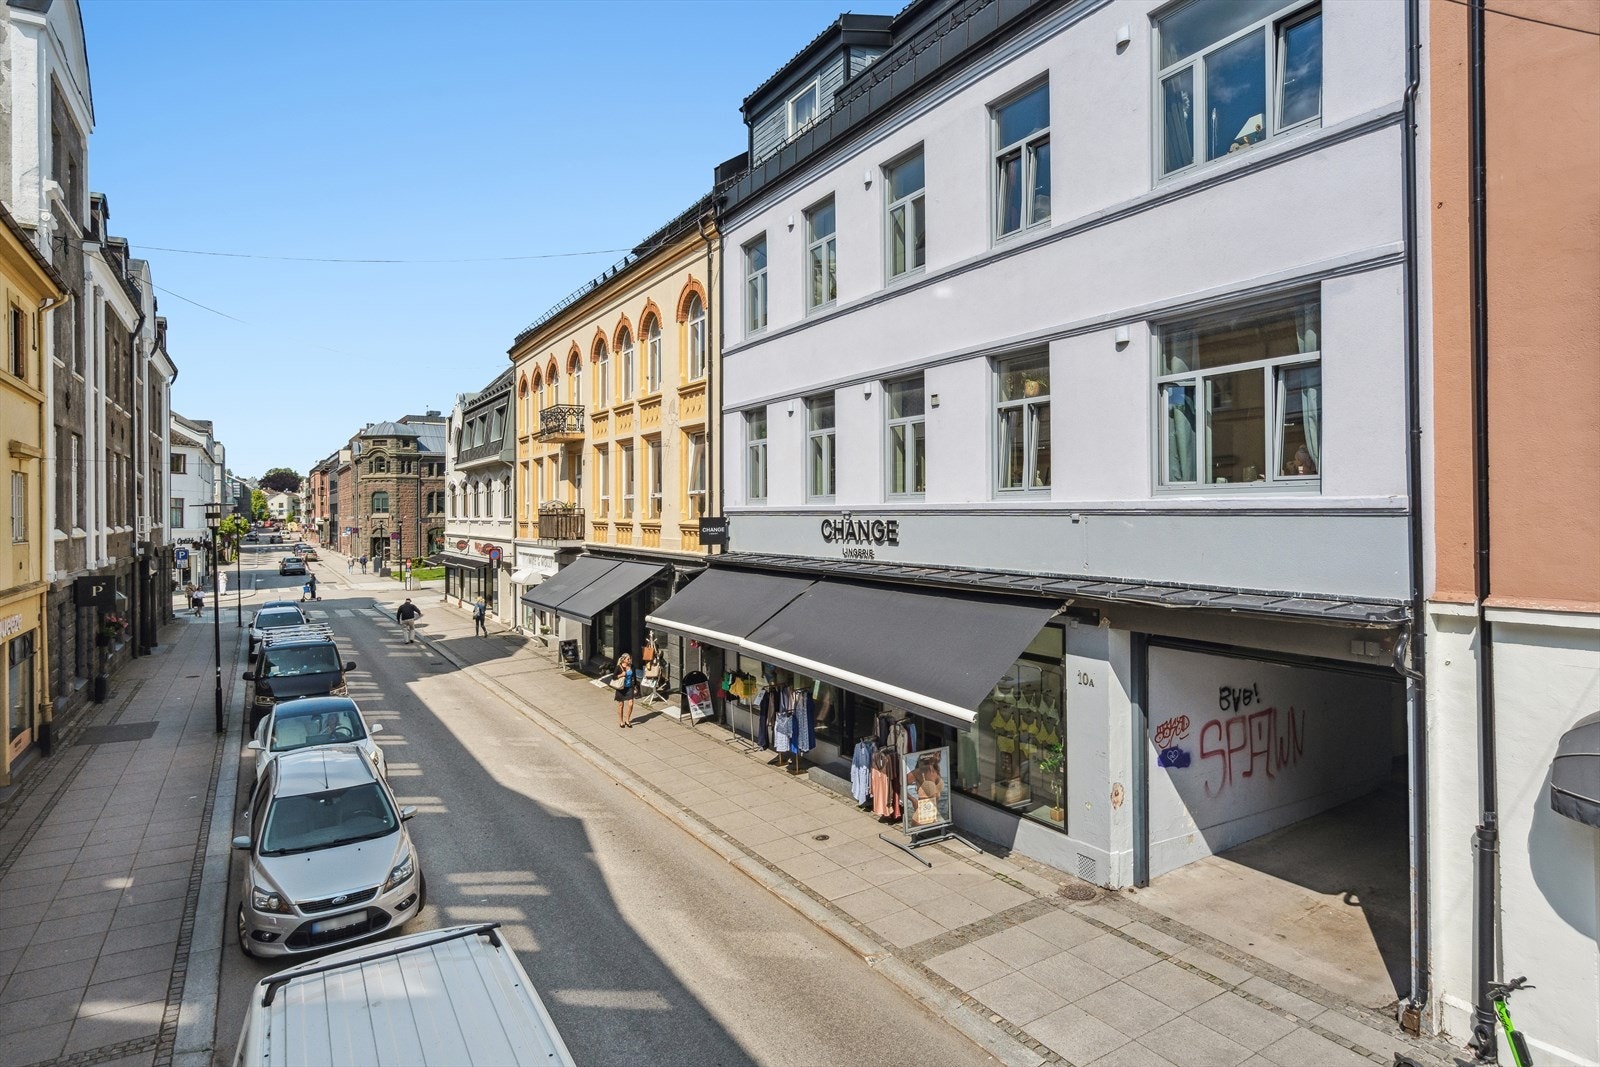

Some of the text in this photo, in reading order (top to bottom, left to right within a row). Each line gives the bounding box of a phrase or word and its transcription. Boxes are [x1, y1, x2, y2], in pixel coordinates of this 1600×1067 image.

[821, 519, 898, 542] CHANGE
[178, 551, 186, 559] P
[842, 548, 874, 558] LINGERIE
[92, 585, 104, 597] P
[1077, 670, 1095, 688] 10A
[1199, 706, 1306, 799] SPAWN
